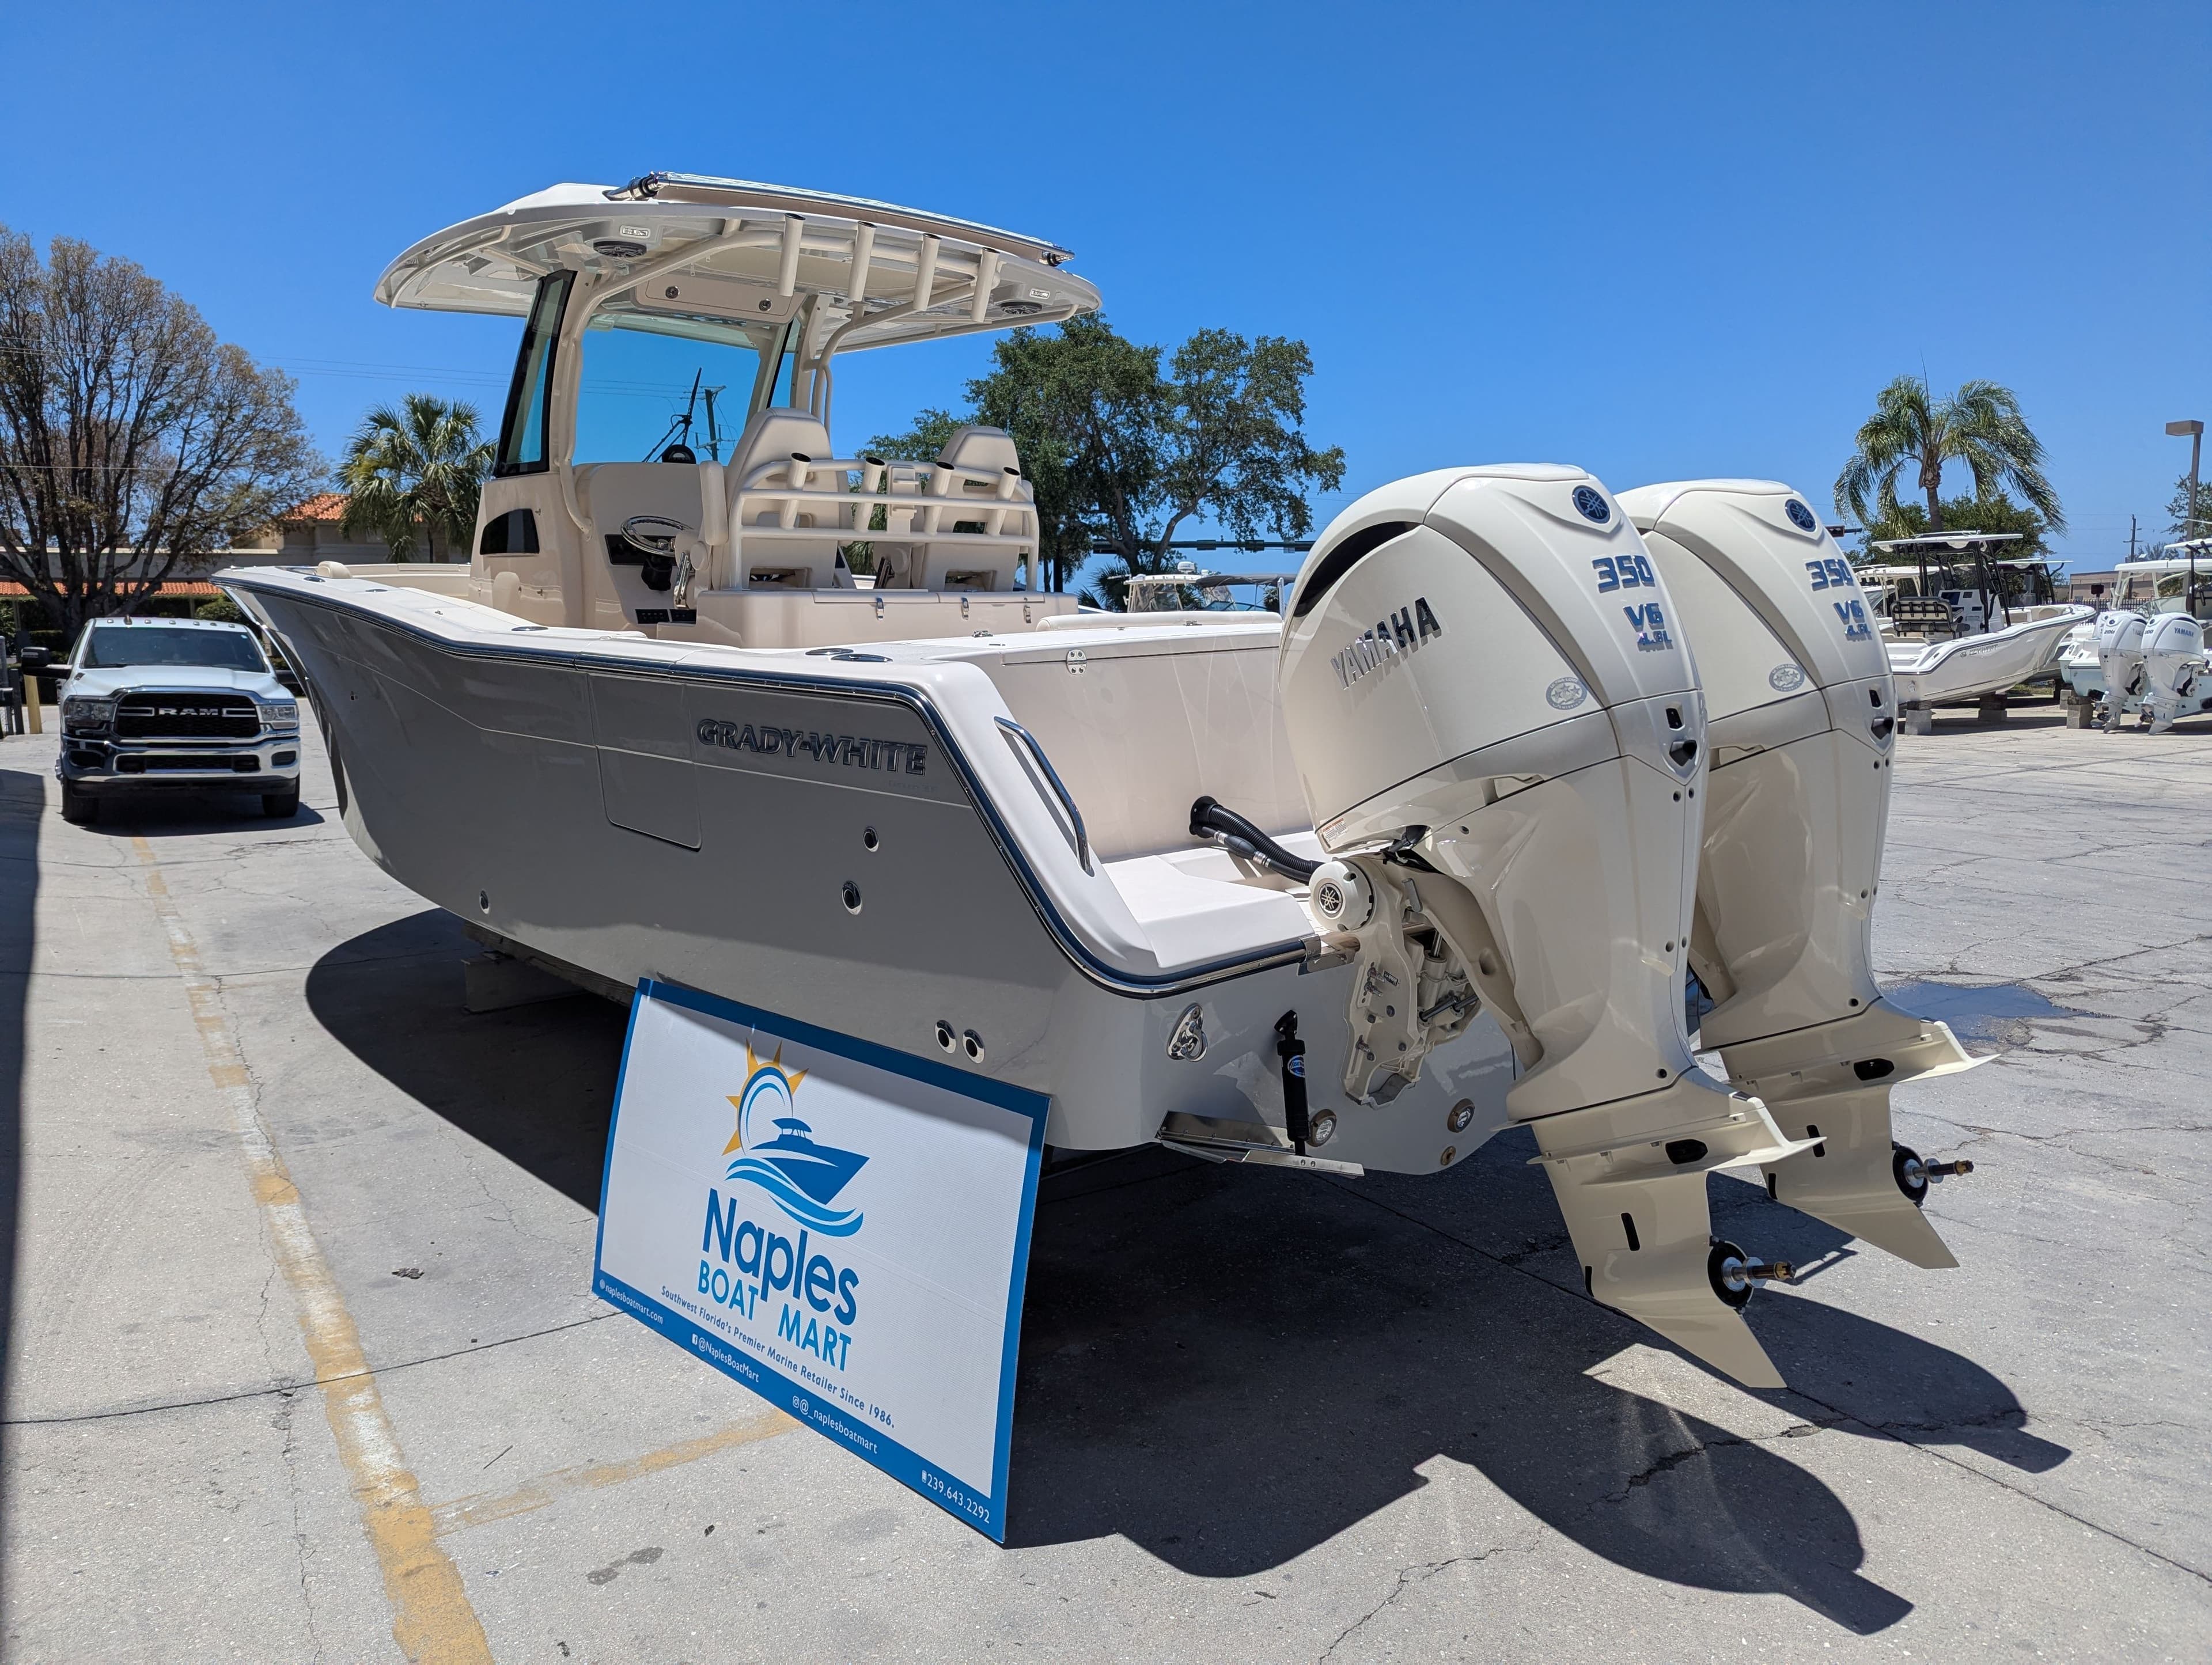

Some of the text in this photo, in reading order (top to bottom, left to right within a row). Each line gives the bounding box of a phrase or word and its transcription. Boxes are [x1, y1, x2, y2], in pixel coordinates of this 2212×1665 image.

[1592, 555, 1655, 592] 350
[1805, 559, 1854, 590] 350
[1622, 602, 1664, 629] V6
[1833, 600, 1865, 623] V6
[2174, 627, 2194, 637] YAMAHA
[1330, 596, 1442, 691] YAMAHA
[158, 708, 218, 716] RAM
[696, 718, 929, 776] GRADY-WHITE
[702, 1187, 859, 1326] Naples
[605, 1285, 664, 1325] naplesboatmart.com
[698, 1259, 852, 1372] BOAT MART
[661, 1285, 895, 1429] Southwest Florida's Premier Marine Retailer Since 1986.
[698, 1337, 760, 1383] @NaplesBoatMart
[800, 1399, 878, 1454] @_naplesboatmart
[927, 1473, 990, 1524] 239.643.2292
